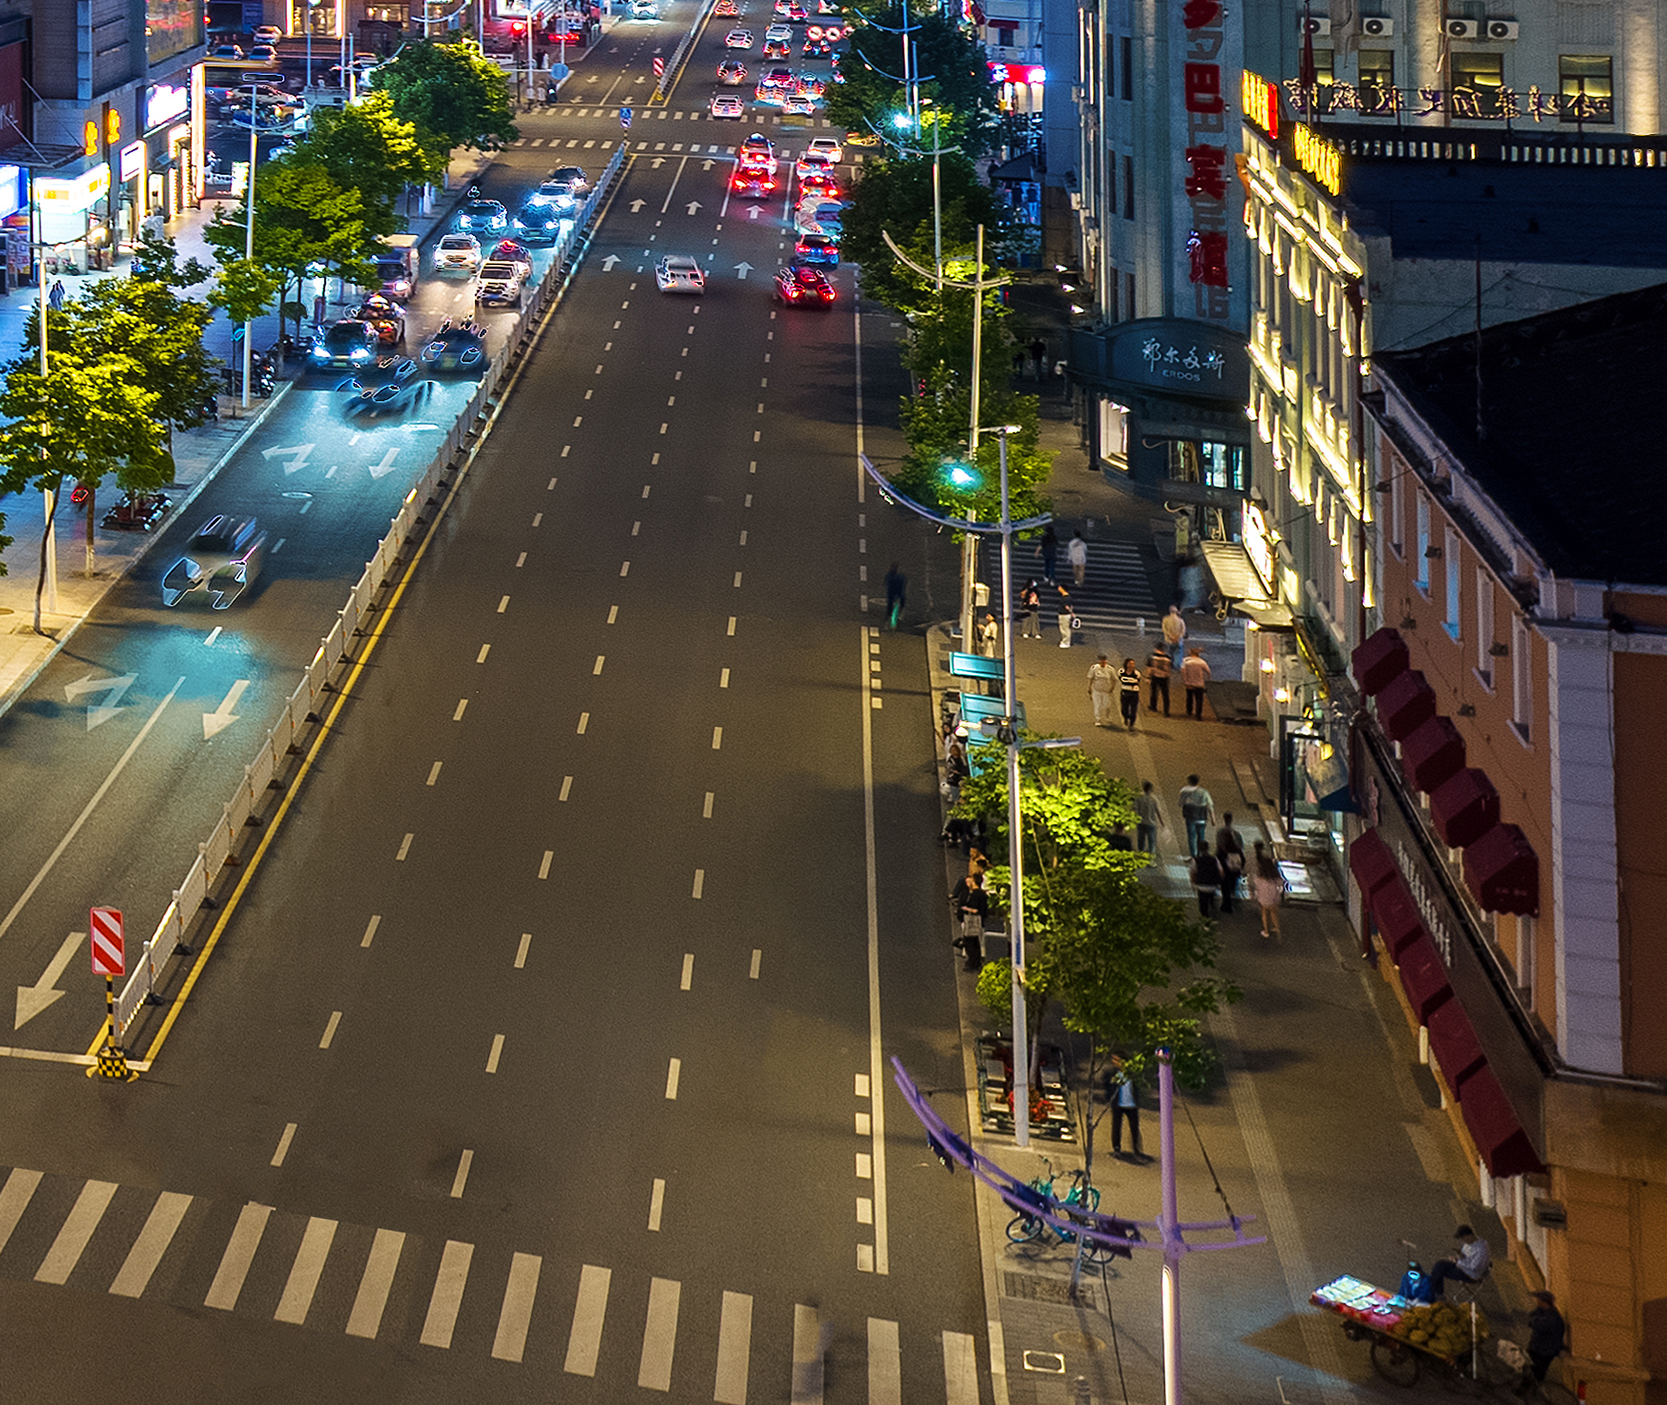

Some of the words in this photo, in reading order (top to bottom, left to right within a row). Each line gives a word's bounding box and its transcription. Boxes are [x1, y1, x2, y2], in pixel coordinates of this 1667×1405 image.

[1142, 337, 1225, 379] 鄂尔多斯
[1162, 369, 1200, 382] ERDOS
